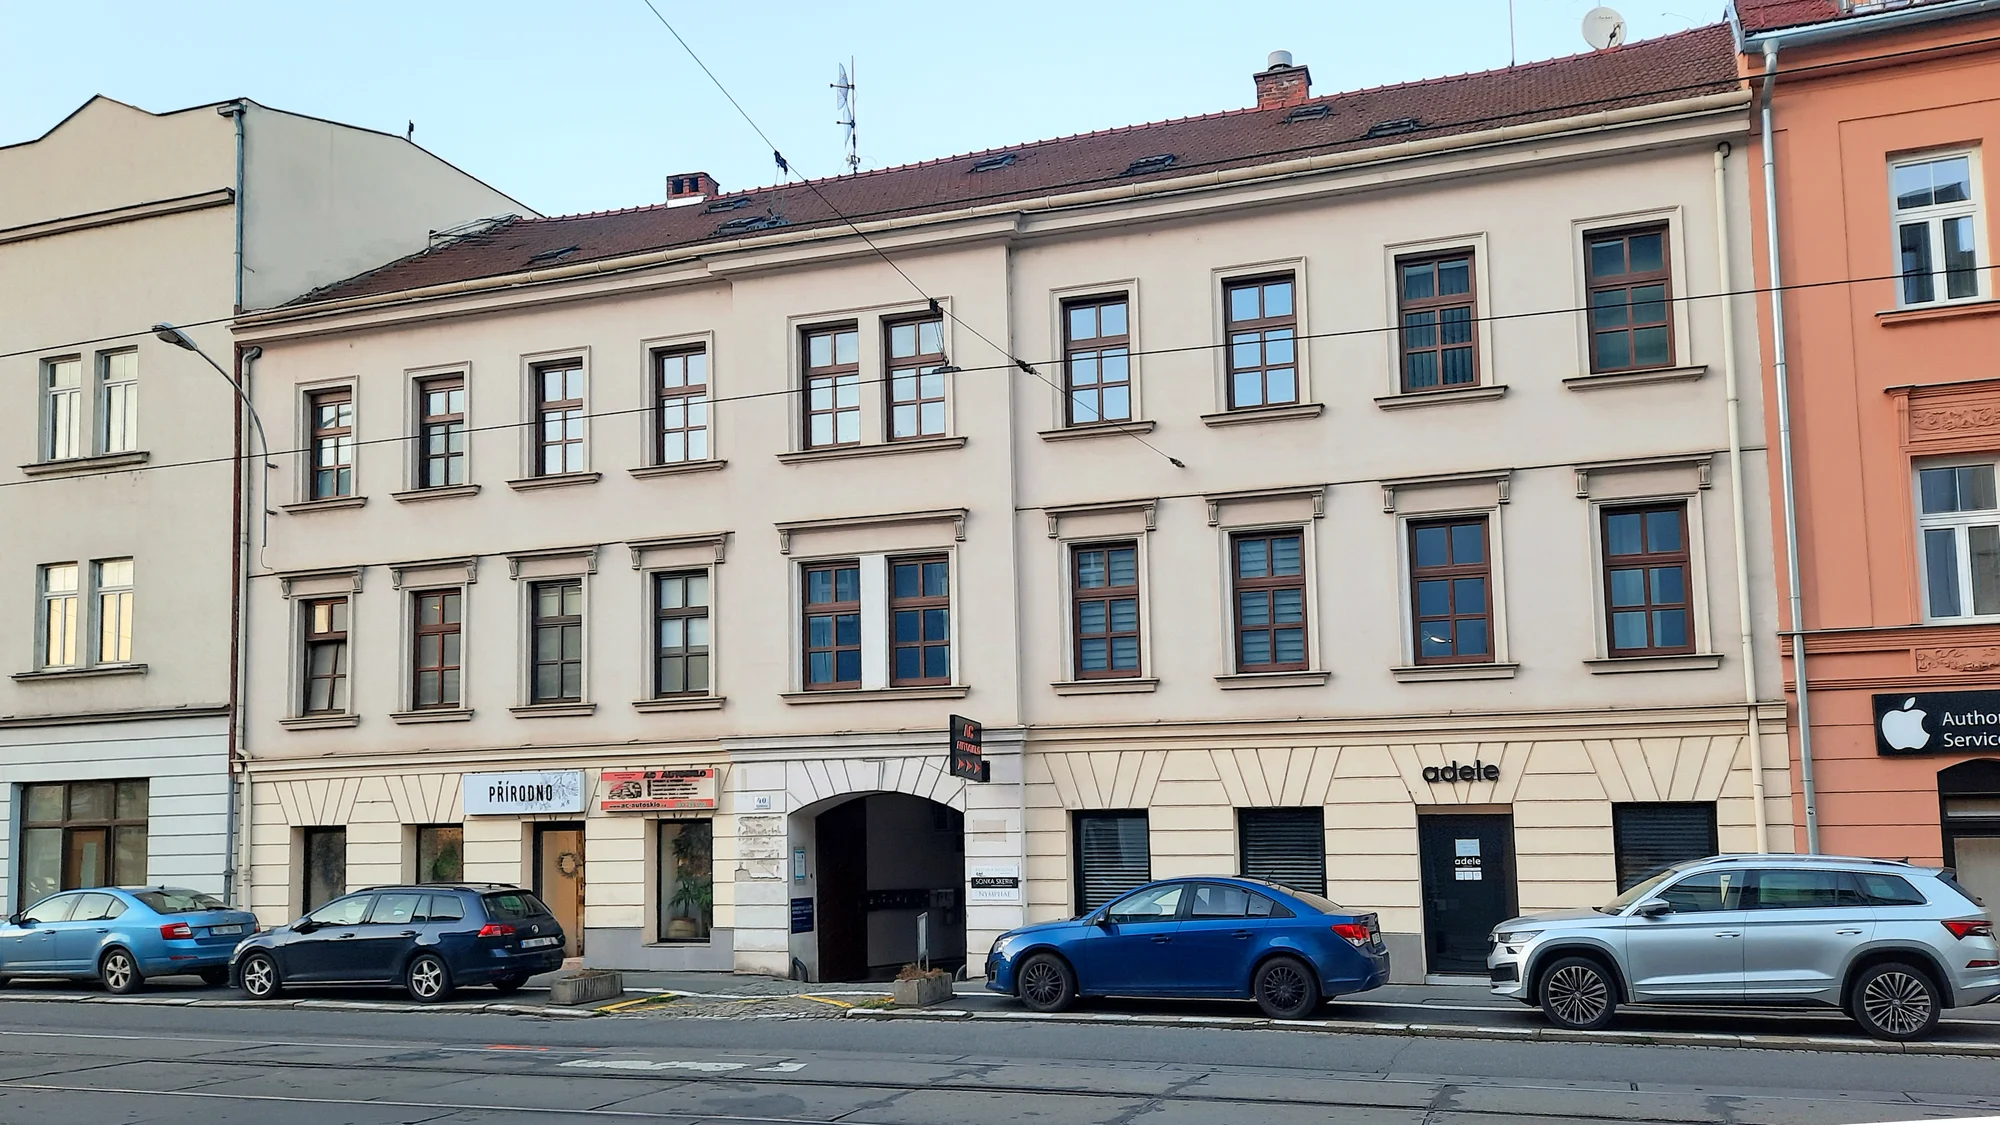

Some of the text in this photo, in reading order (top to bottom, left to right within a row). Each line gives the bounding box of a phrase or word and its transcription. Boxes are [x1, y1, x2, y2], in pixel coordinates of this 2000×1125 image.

[963, 724, 974, 739] AC
[1422, 760, 1499, 783] adele
[489, 780, 553, 803] PŘÍRODNO
[1454, 857, 1481, 865] adele
